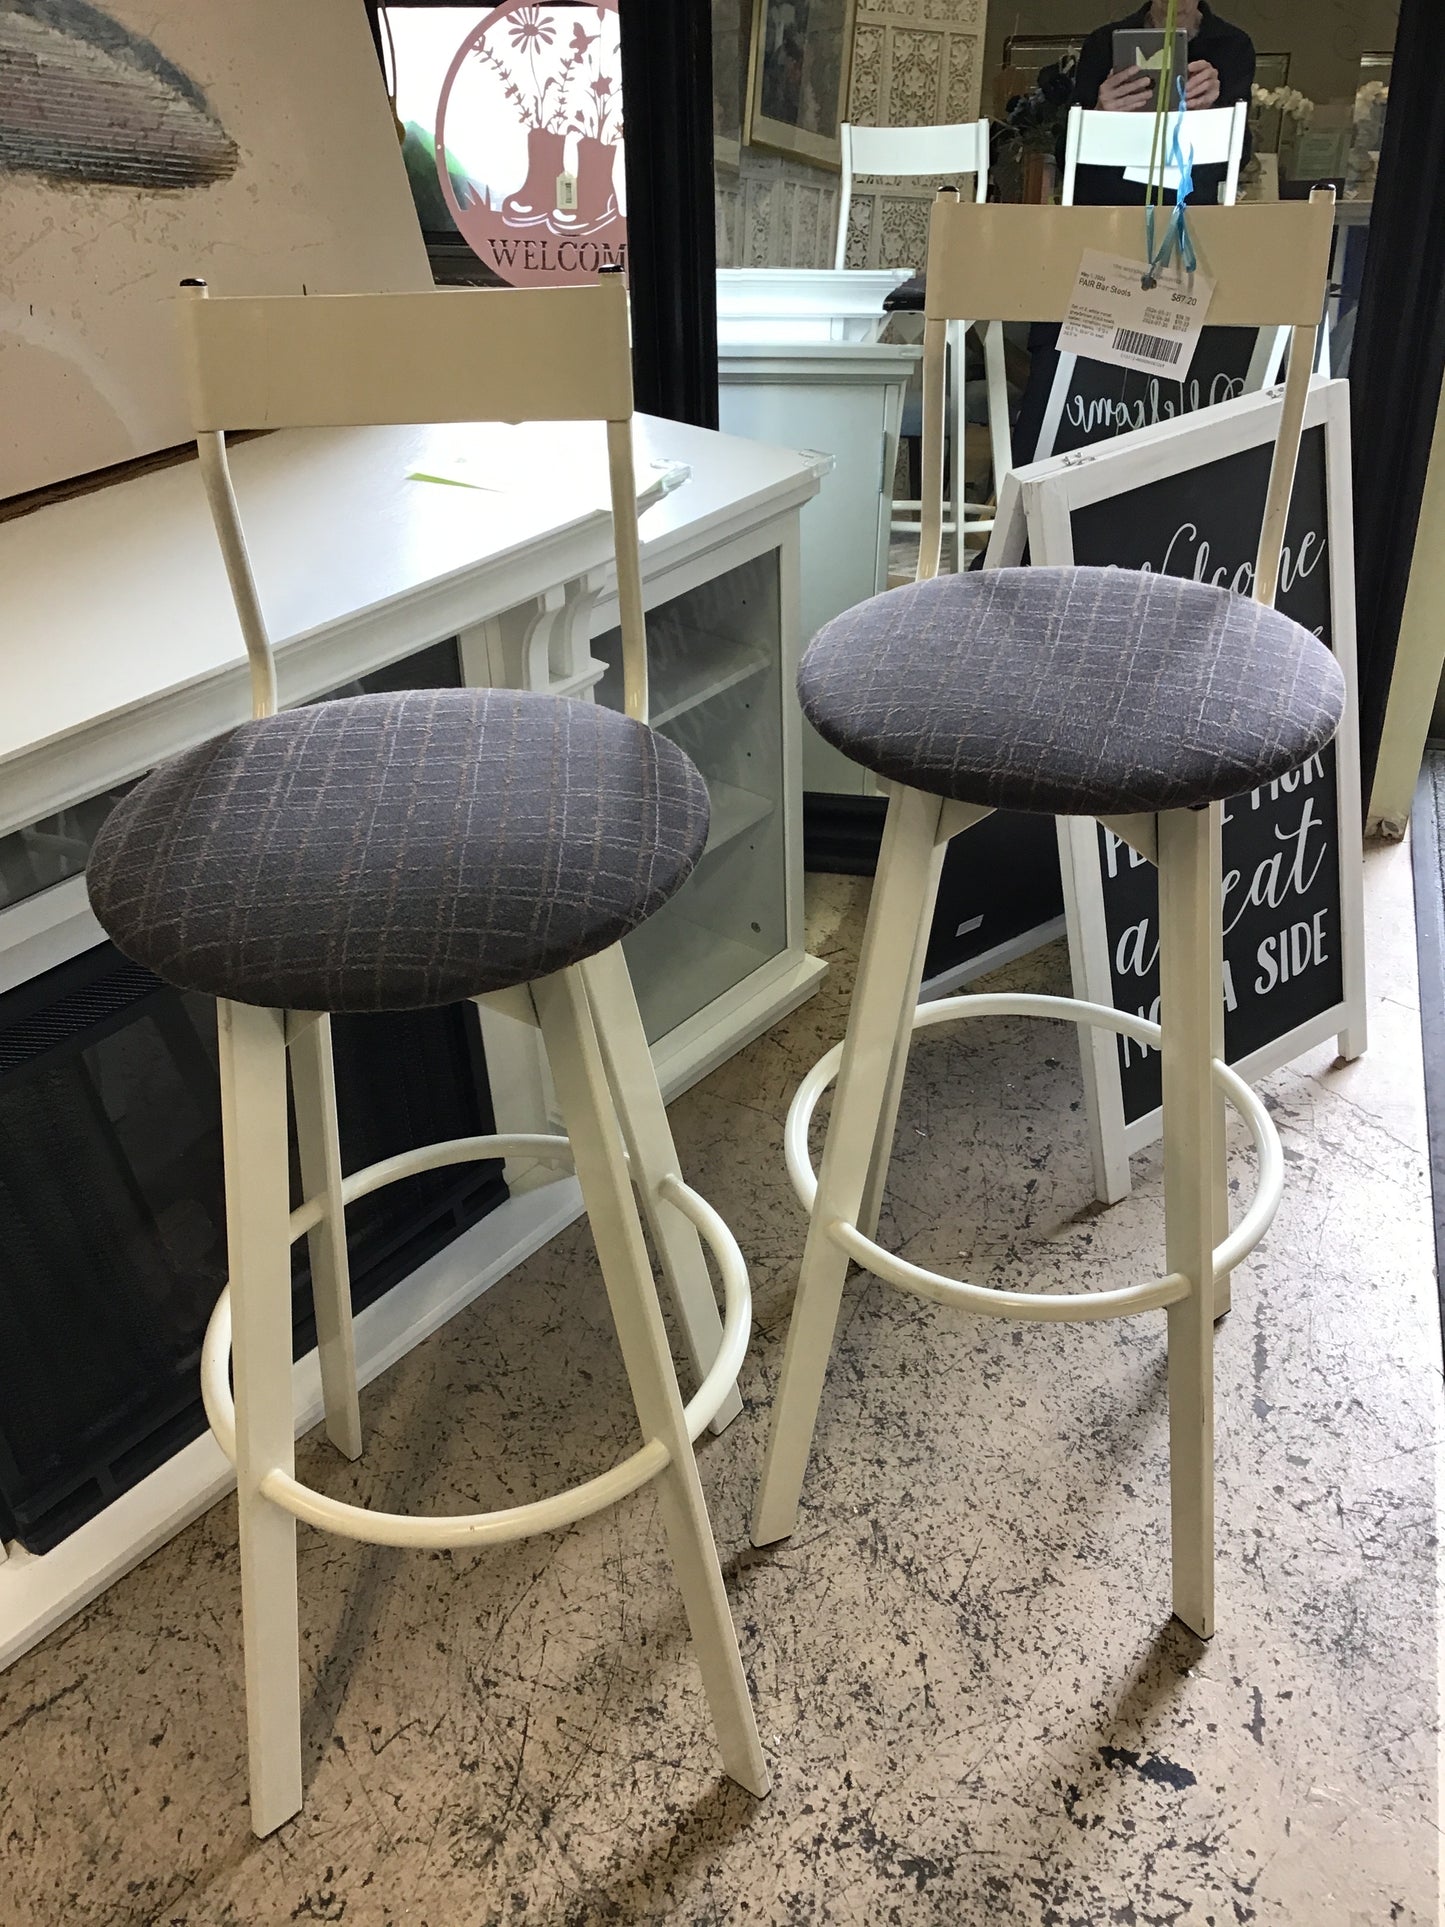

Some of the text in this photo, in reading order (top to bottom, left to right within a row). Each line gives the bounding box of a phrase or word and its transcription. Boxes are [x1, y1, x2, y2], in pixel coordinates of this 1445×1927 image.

[488, 239, 626, 272] WELCOM
[1079, 277, 1131, 297] PAIR Bar Stools
[1171, 292, 1197, 306] $87.20
[1221, 798, 1327, 936] eat
[1254, 907, 1329, 995] SIDE
